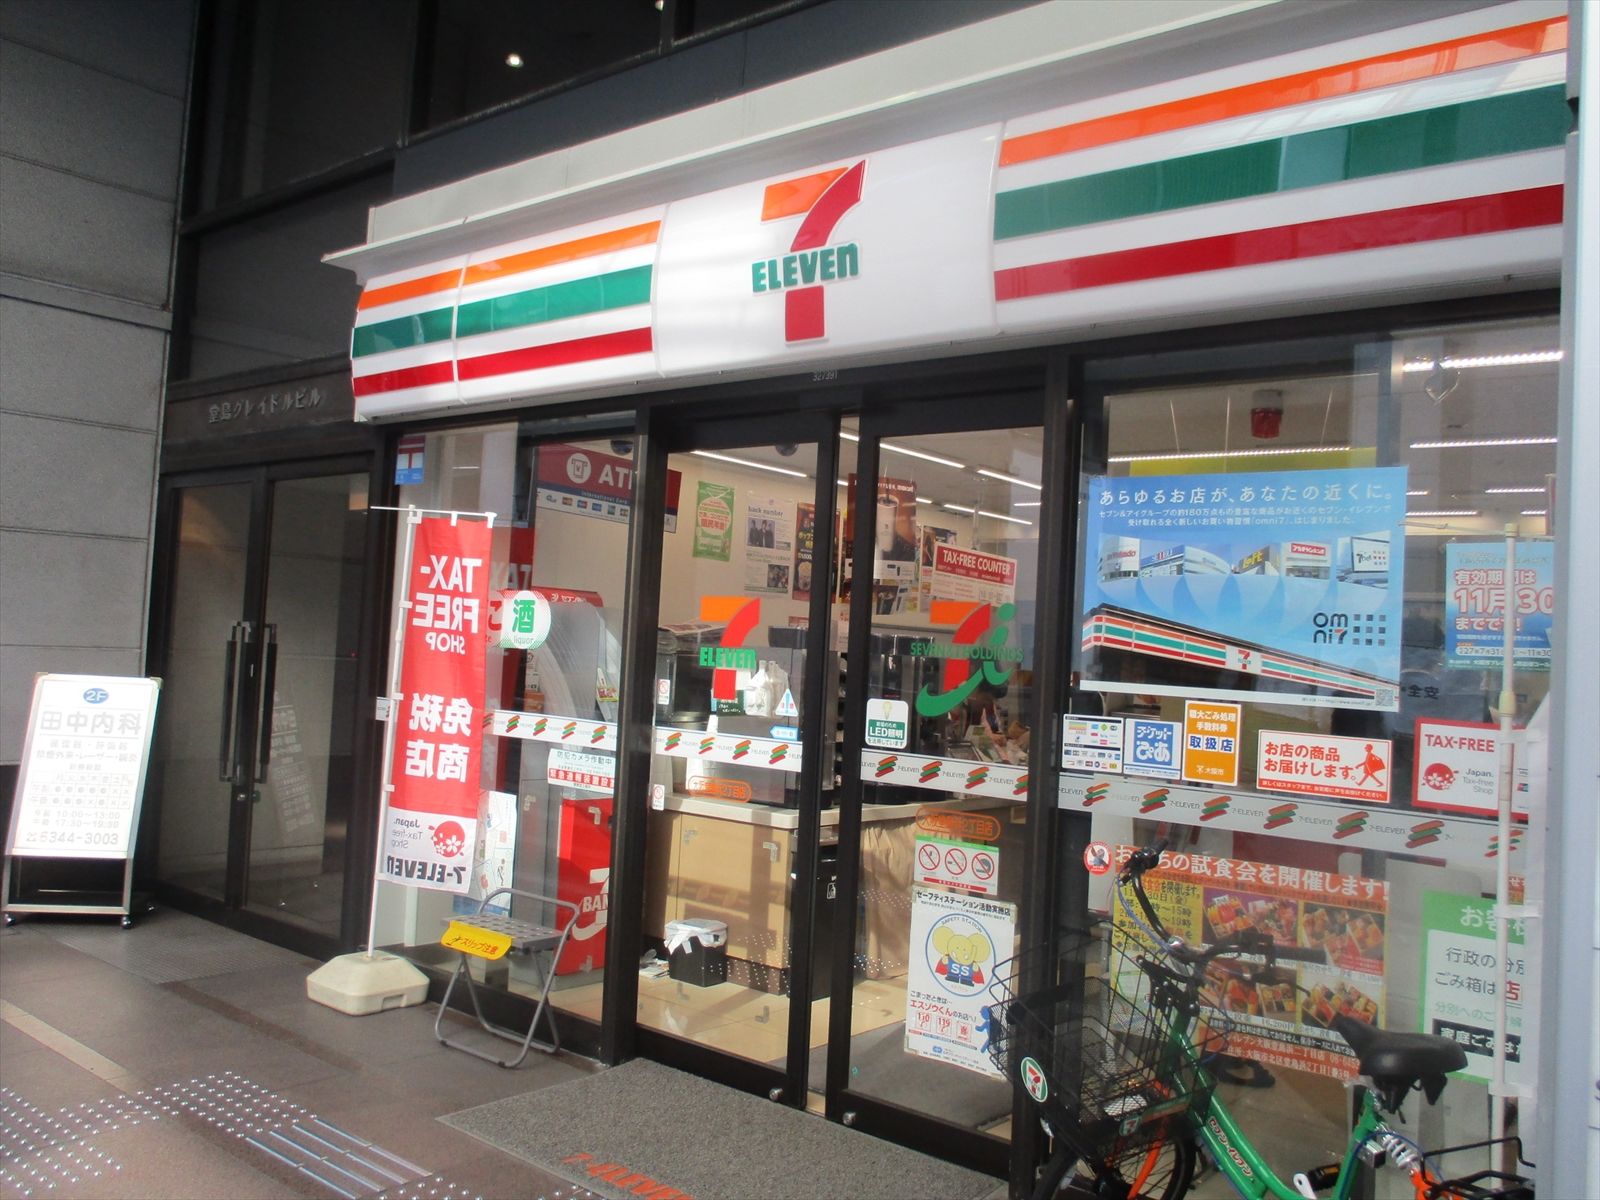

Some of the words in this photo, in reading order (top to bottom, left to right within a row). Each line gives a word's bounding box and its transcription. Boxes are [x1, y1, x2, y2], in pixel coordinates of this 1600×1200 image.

[761, 160, 865, 342] 7
[598, 464, 633, 491] AT
[1099, 483, 1392, 505] あらゆるお店が、あなたの近くに。
[977, 560, 1011, 575] COUNTER
[512, 599, 535, 634] 酒
[85, 690, 107, 702] 2F
[40, 711, 142, 735] 田中内科
[1136, 725, 1172, 740] チケット
[1135, 740, 1170, 762] ぴあ
[1190, 735, 1233, 752] 取扱店
[1264, 742, 1340, 762] お店の商品
[1424, 733, 1495, 753] TAX-FREE
[1264, 758, 1357, 781] お届けします。
[1464, 768, 1494, 778] Japan.
[1462, 776, 1494, 788] Tax-free
[1473, 785, 1494, 796] Shop
[1115, 845, 1390, 900] おちの試食会を開催します!
[461, 937, 499, 955] スリップ注意
[950, 963, 970, 976] SS
